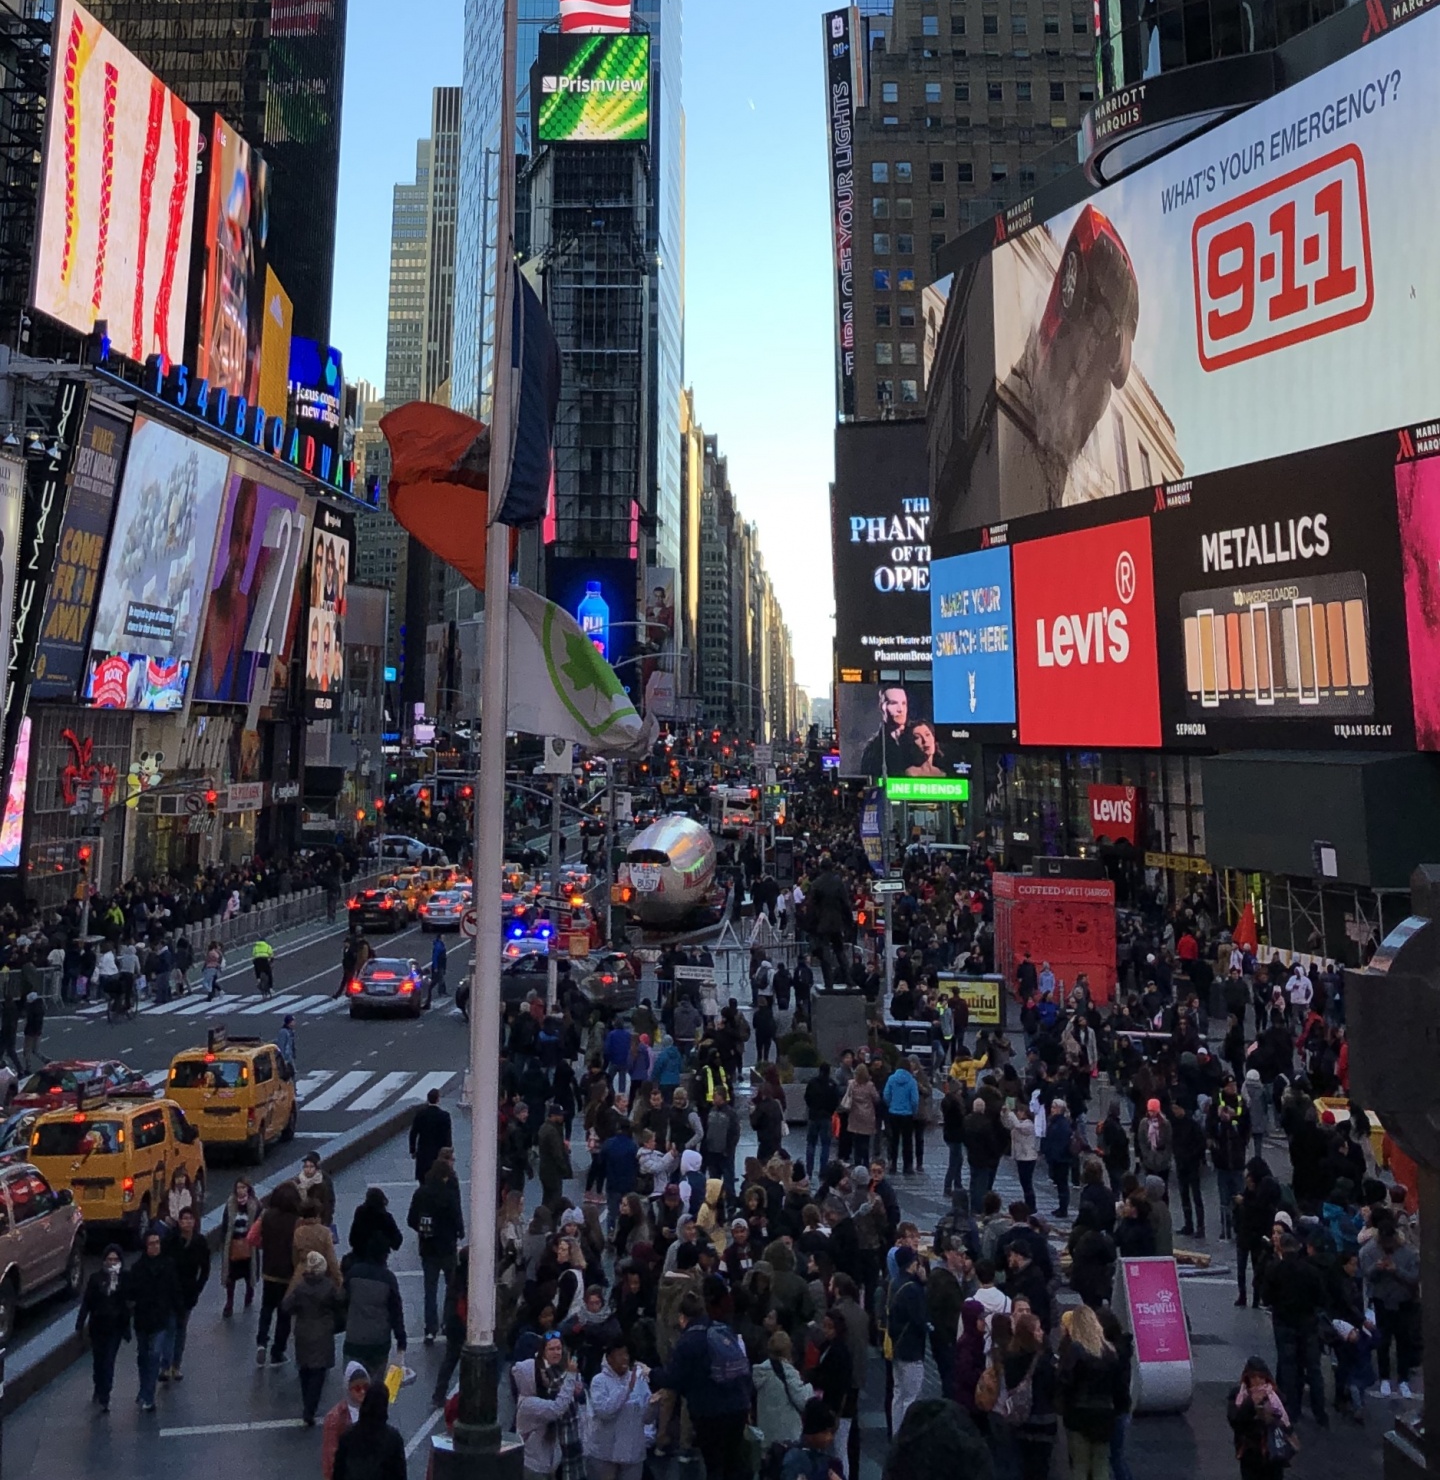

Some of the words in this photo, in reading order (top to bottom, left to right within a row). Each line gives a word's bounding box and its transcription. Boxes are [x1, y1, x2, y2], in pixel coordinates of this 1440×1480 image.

[558, 75, 644, 93] Prismview
[1094, 85, 1146, 121] MARRIOTT
[833, 80, 853, 168] LIGHTS
[1095, 107, 1139, 140] MARQUIS
[1161, 163, 1216, 214] WHAT'S
[1219, 139, 1266, 186] YOUR
[1269, 68, 1402, 162] EMERGENCY?
[838, 170, 853, 246] YOUR
[1006, 196, 1034, 220] MARRIOTT
[1007, 212, 1032, 234] MARQUIS
[156, 353, 229, 427] 1540
[234, 395, 358, 494] BROADWAY
[1166, 480, 1193, 497] MARRIOTT
[1166, 491, 1191, 508] MARQUIS
[61, 526, 104, 570] COME
[891, 545, 913, 562] OF
[1201, 513, 1330, 573] METALLICS
[971, 585, 1001, 615] YOUR
[44, 602, 91, 643] AWAY
[868, 636, 895, 647] Majestic
[896, 636, 920, 646] Theatre
[1175, 723, 1207, 736] SEPHORA
[1334, 724, 1363, 739] URBAN
[1364, 724, 1393, 736] DECAY
[913, 783, 962, 795] FRIENDS
